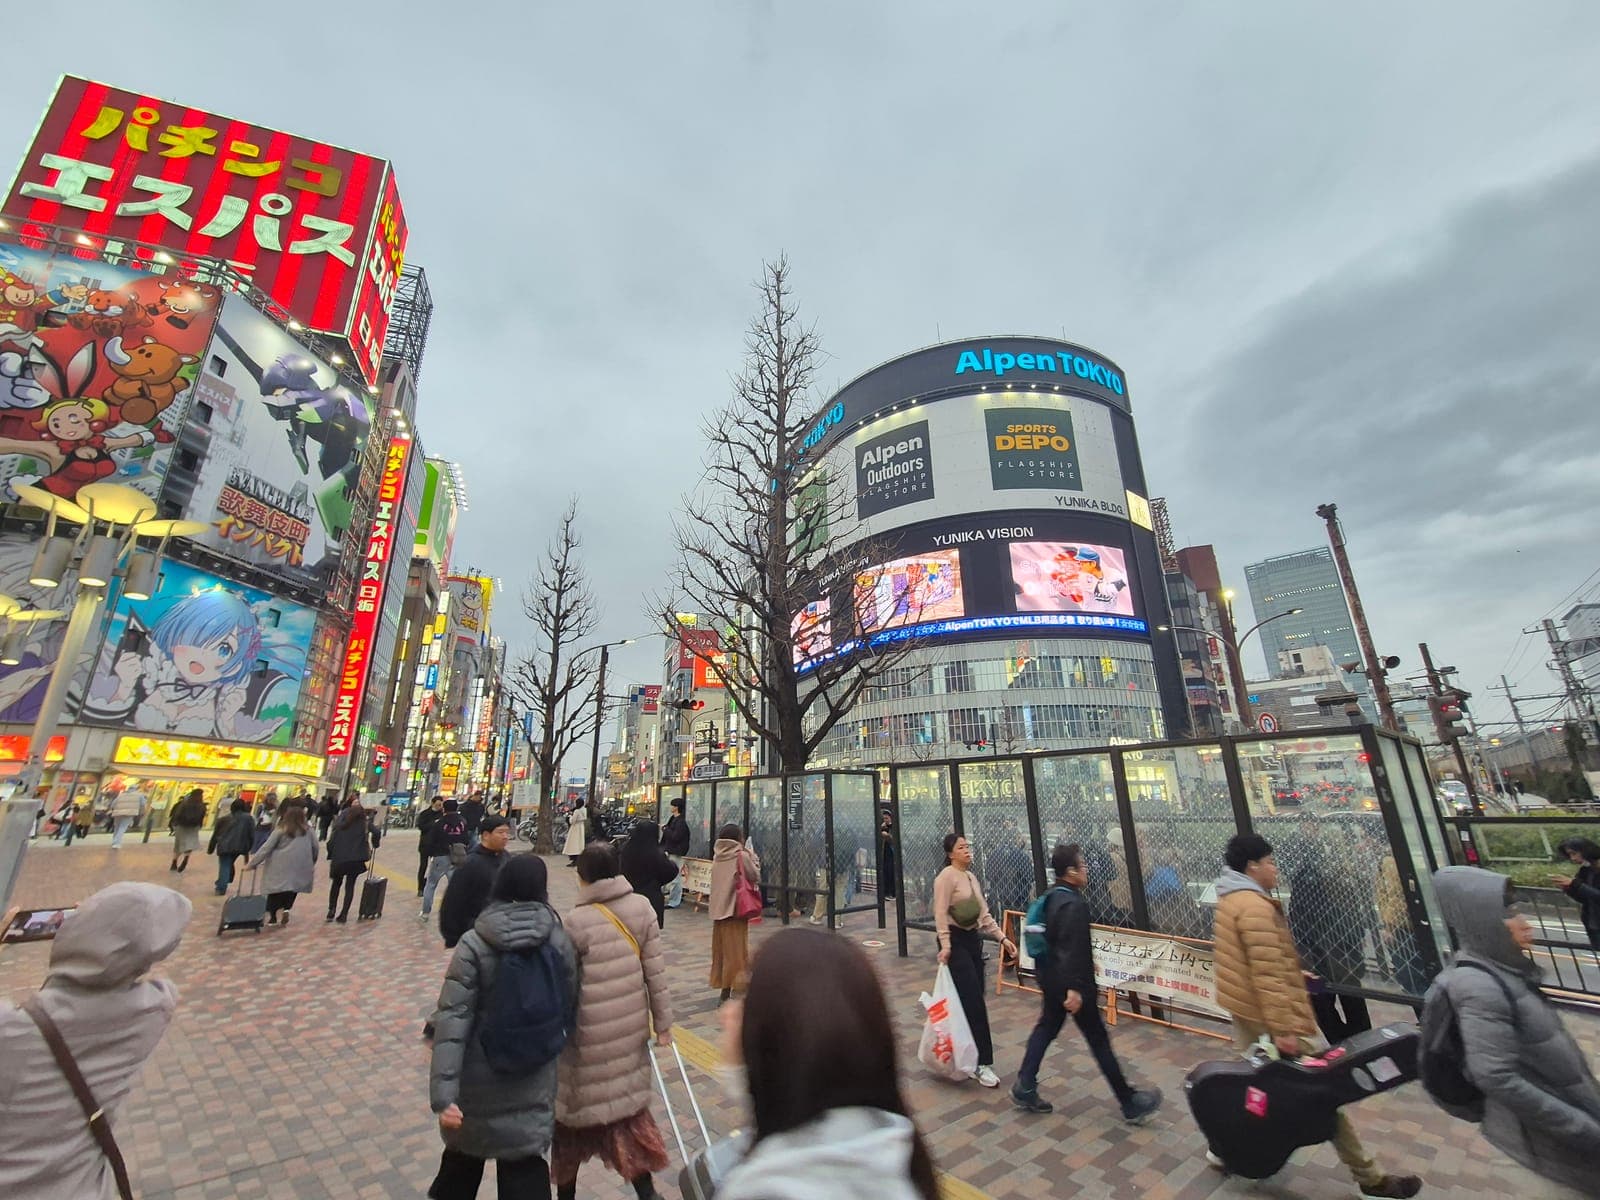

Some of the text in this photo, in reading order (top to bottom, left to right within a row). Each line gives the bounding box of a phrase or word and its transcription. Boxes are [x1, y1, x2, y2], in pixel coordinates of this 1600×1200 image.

[81, 106, 342, 197] パチンコ
[19, 153, 356, 267] エスパス
[955, 348, 1123, 395] Alpen TOKYO
[995, 434, 1070, 452] DEPO
[1006, 424, 1057, 434] SPORTS
[861, 436, 923, 469] Alpen
[998, 460, 1073, 469] FLAGSHIP
[381, 445, 405, 499] パチンコ
[862, 472, 926, 499] FLAGSHIP
[867, 457, 924, 486] Outdoors
[1028, 470, 1074, 479] STORE
[884, 482, 927, 499] STORE
[1055, 495, 1099, 510] YUNIKA
[218, 485, 310, 546] 歌舞伎町
[211, 515, 304, 567] インパクト
[363, 501, 393, 581] エスパス
[933, 527, 1034, 546] YUNIKA VISION
[328, 639, 365, 751] パチンコ エスパス
